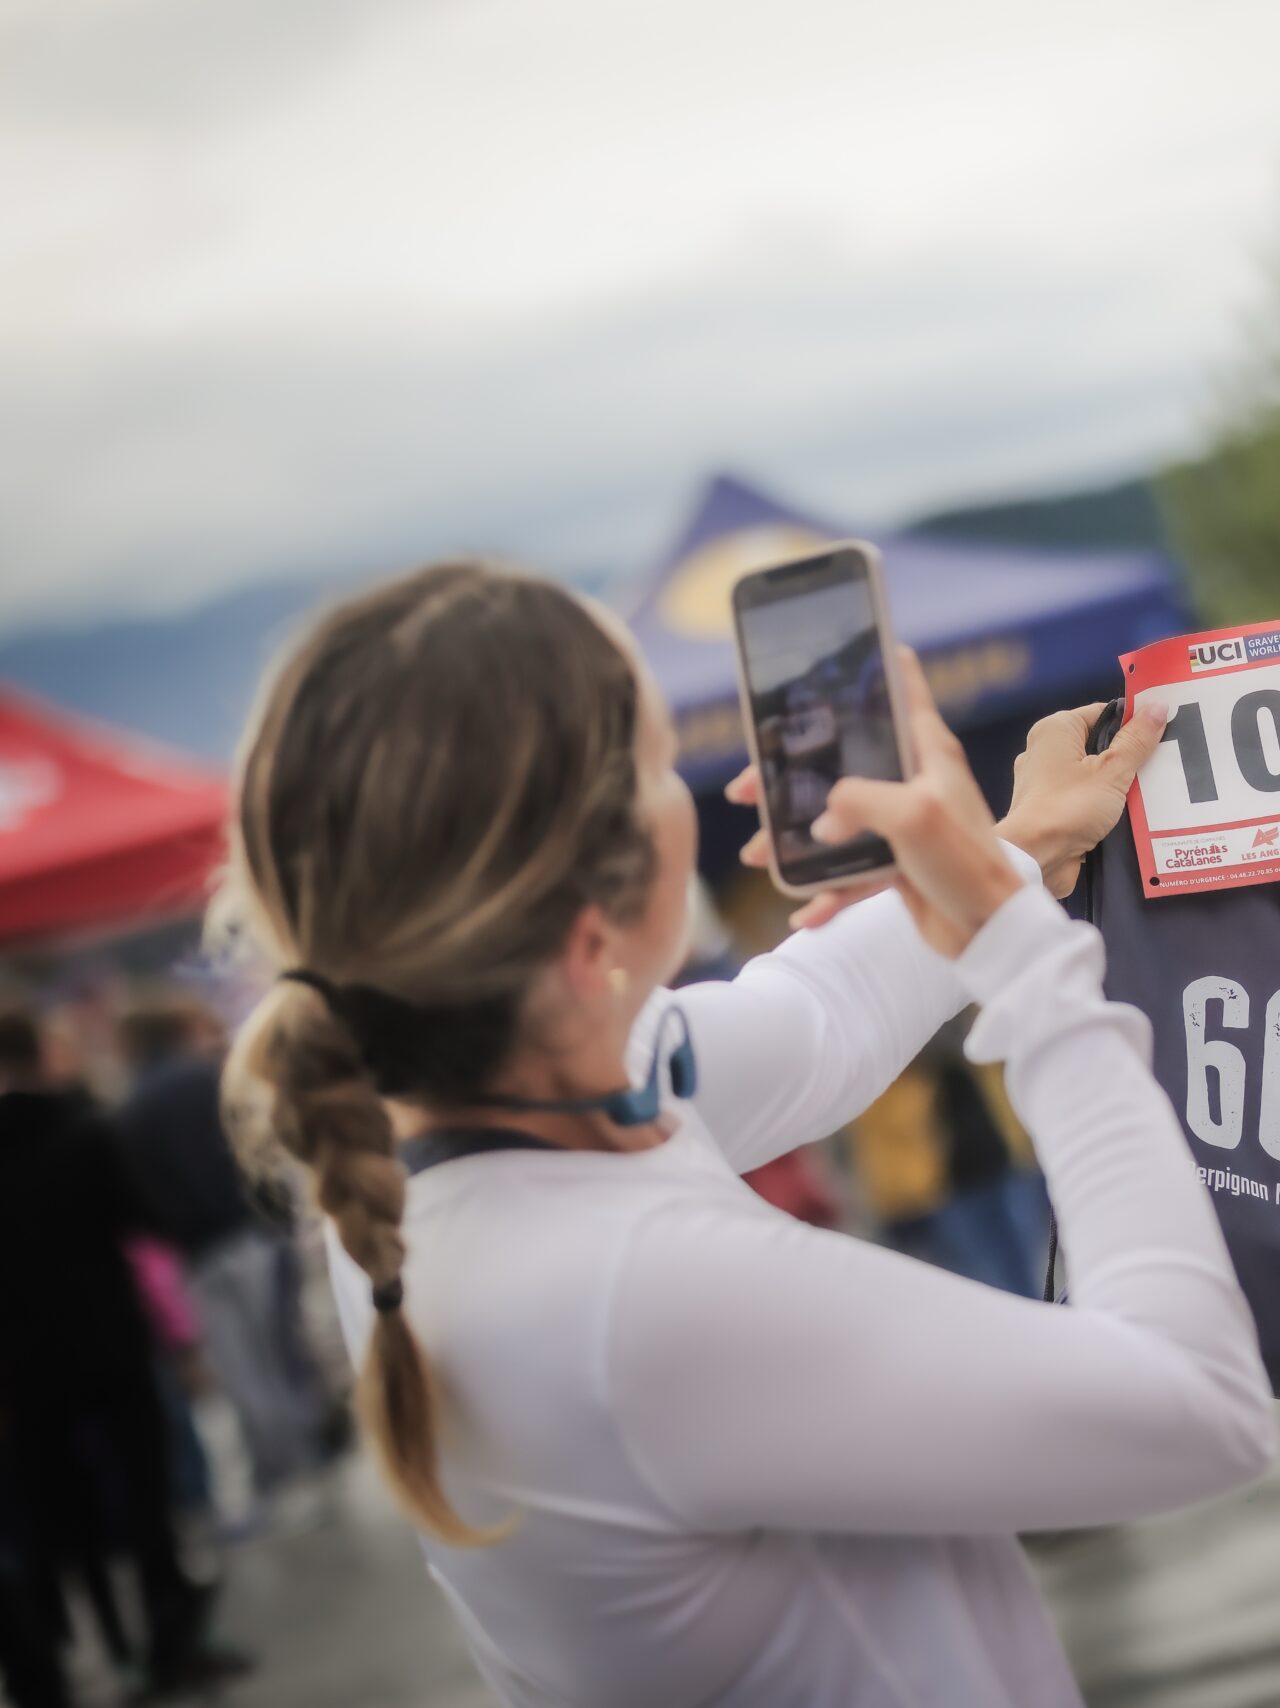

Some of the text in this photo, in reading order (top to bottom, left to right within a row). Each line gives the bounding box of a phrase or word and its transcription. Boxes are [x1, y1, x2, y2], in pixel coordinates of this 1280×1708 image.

[1198, 641, 1243, 665] UCI
[1241, 852, 1257, 861] LES
[1190, 1161, 1269, 1201] erpignan
